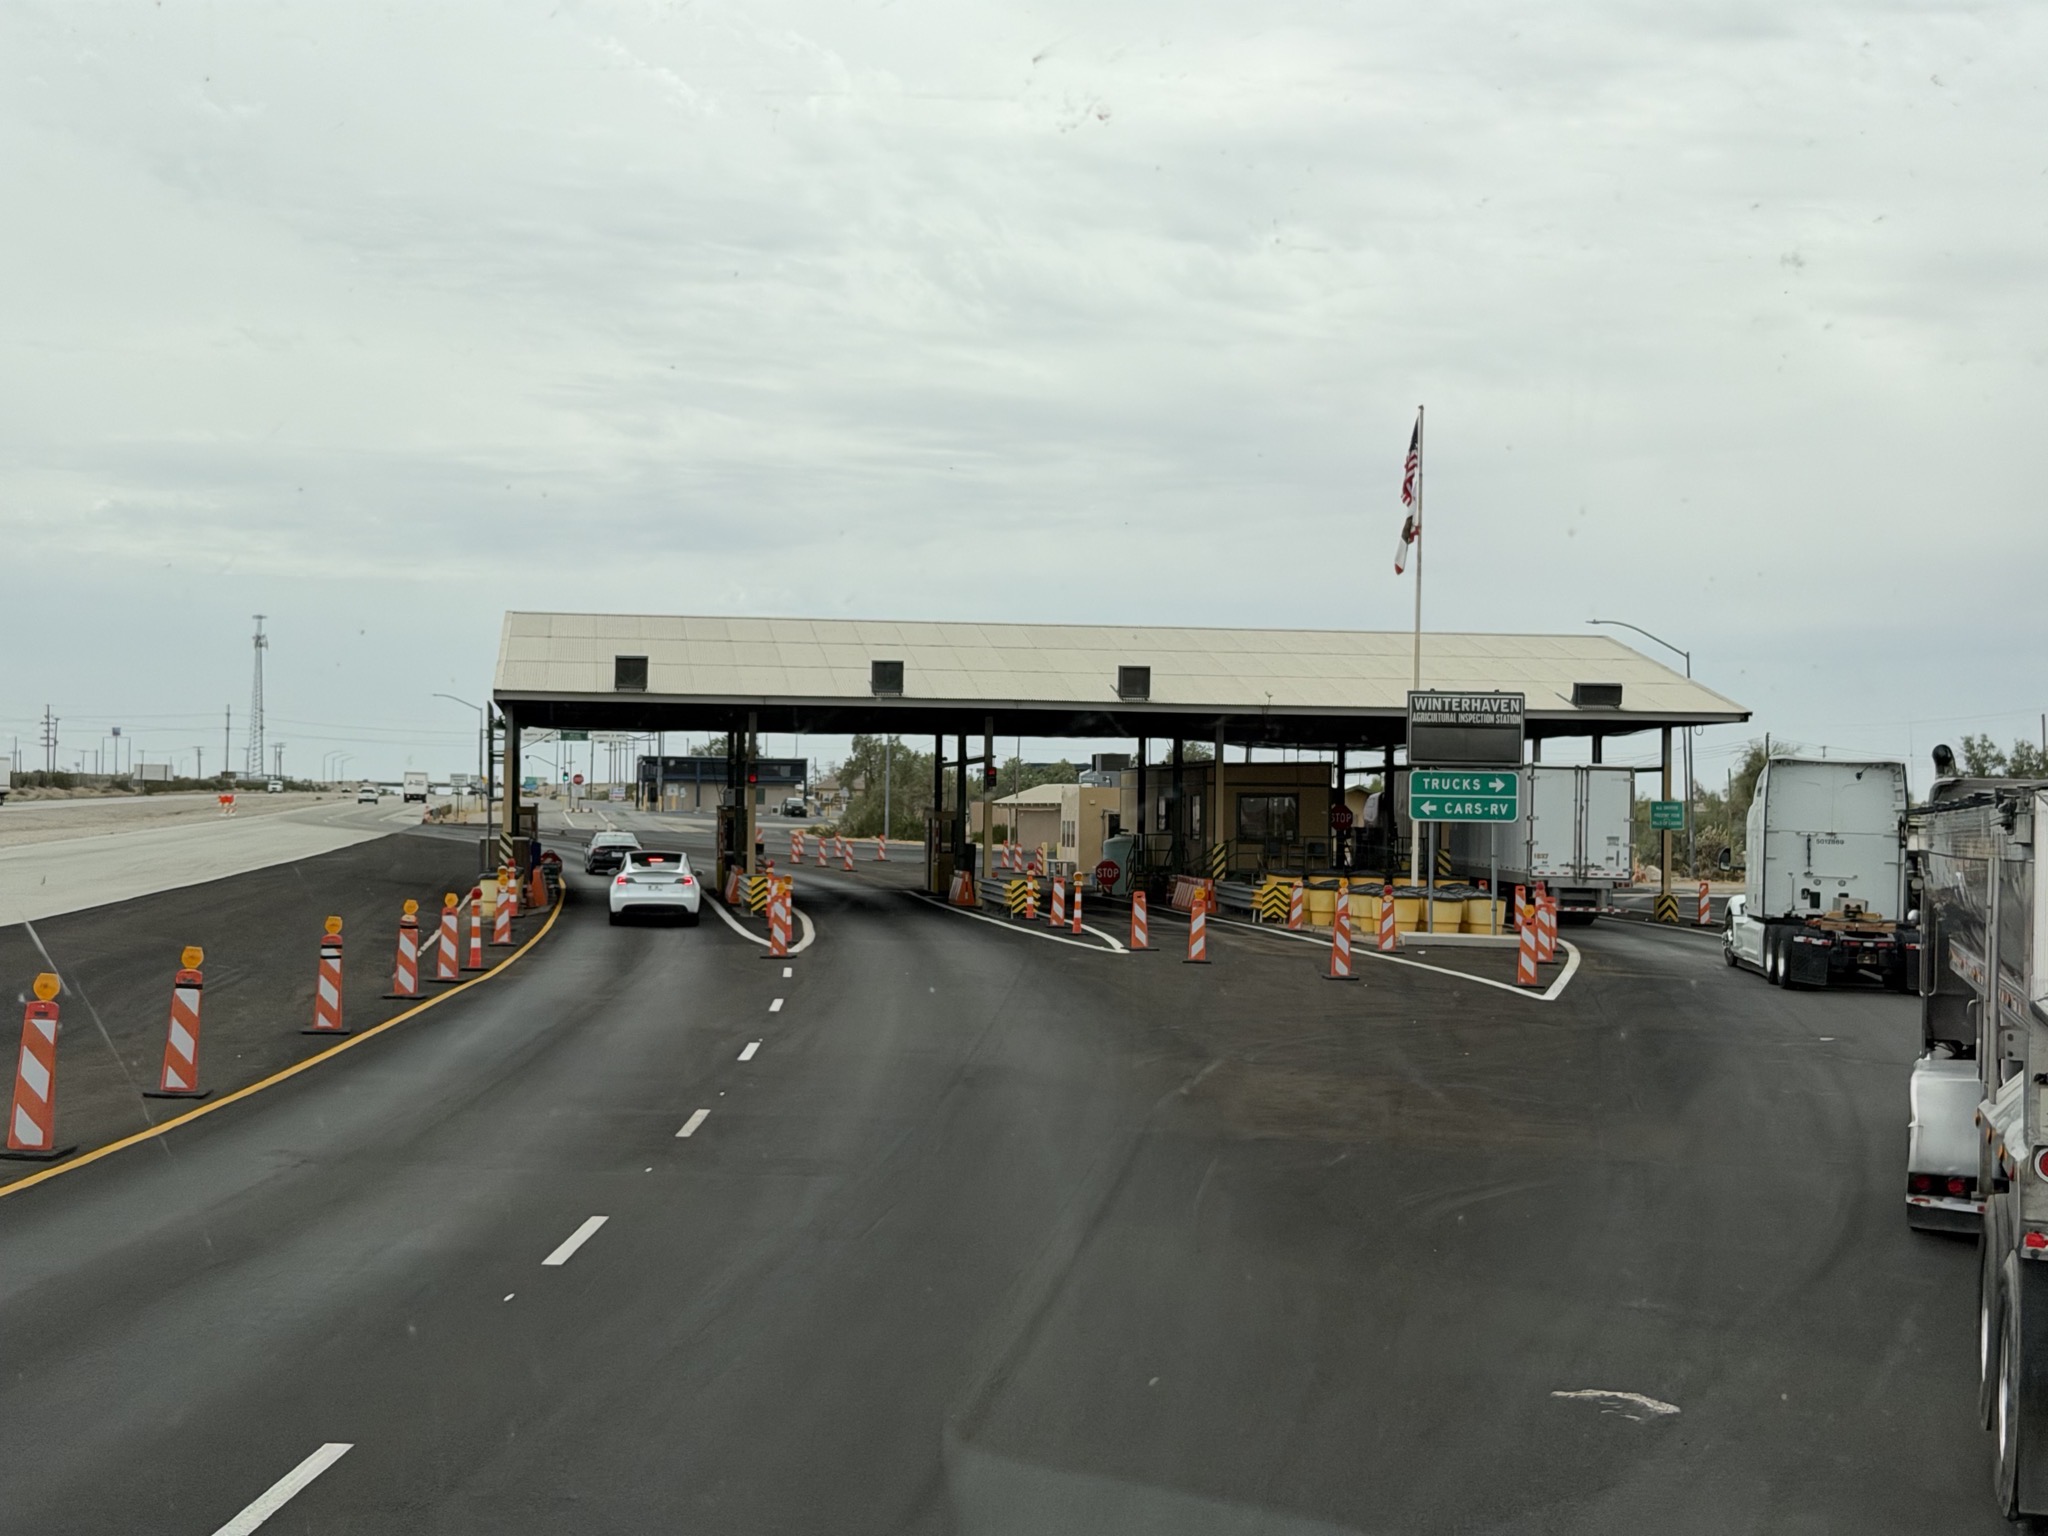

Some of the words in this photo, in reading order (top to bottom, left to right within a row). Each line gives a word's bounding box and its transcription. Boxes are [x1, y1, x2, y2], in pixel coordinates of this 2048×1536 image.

[1414, 697, 1520, 712] WINTERHAVEN
[1412, 712, 1457, 723] AGRICULTURAL
[1458, 713, 1494, 724] INSPECTION
[1496, 714, 1521, 724] STATION
[1423, 778, 1481, 790] TRUCKS
[1444, 802, 1508, 815] CARS-RV
[1331, 812, 1352, 823] STOP
[1097, 867, 1119, 878] STOP
